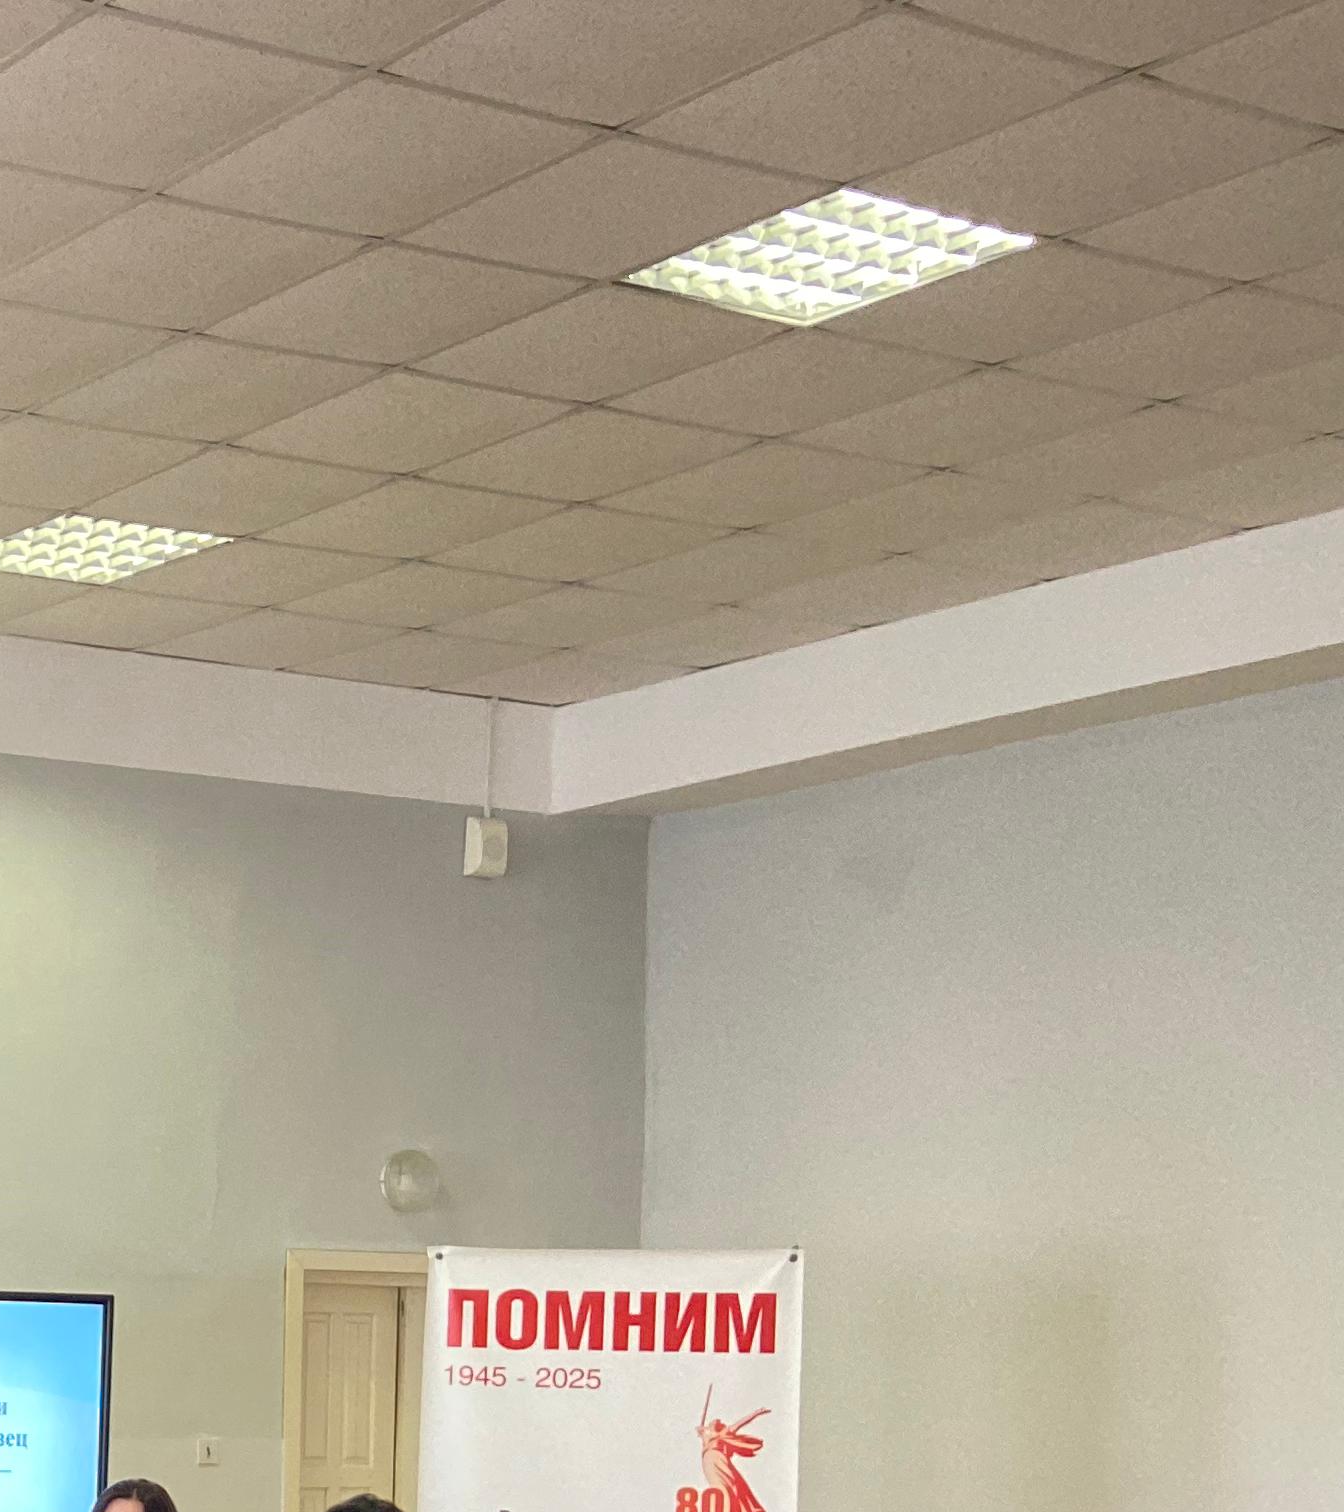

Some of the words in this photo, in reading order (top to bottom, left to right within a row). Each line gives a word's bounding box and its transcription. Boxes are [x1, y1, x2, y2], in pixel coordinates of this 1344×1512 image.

[446, 1288, 777, 1353] ПОМНИМ
[444, 1365, 507, 1387] 1945
[535, 1366, 602, 1389] 2025
